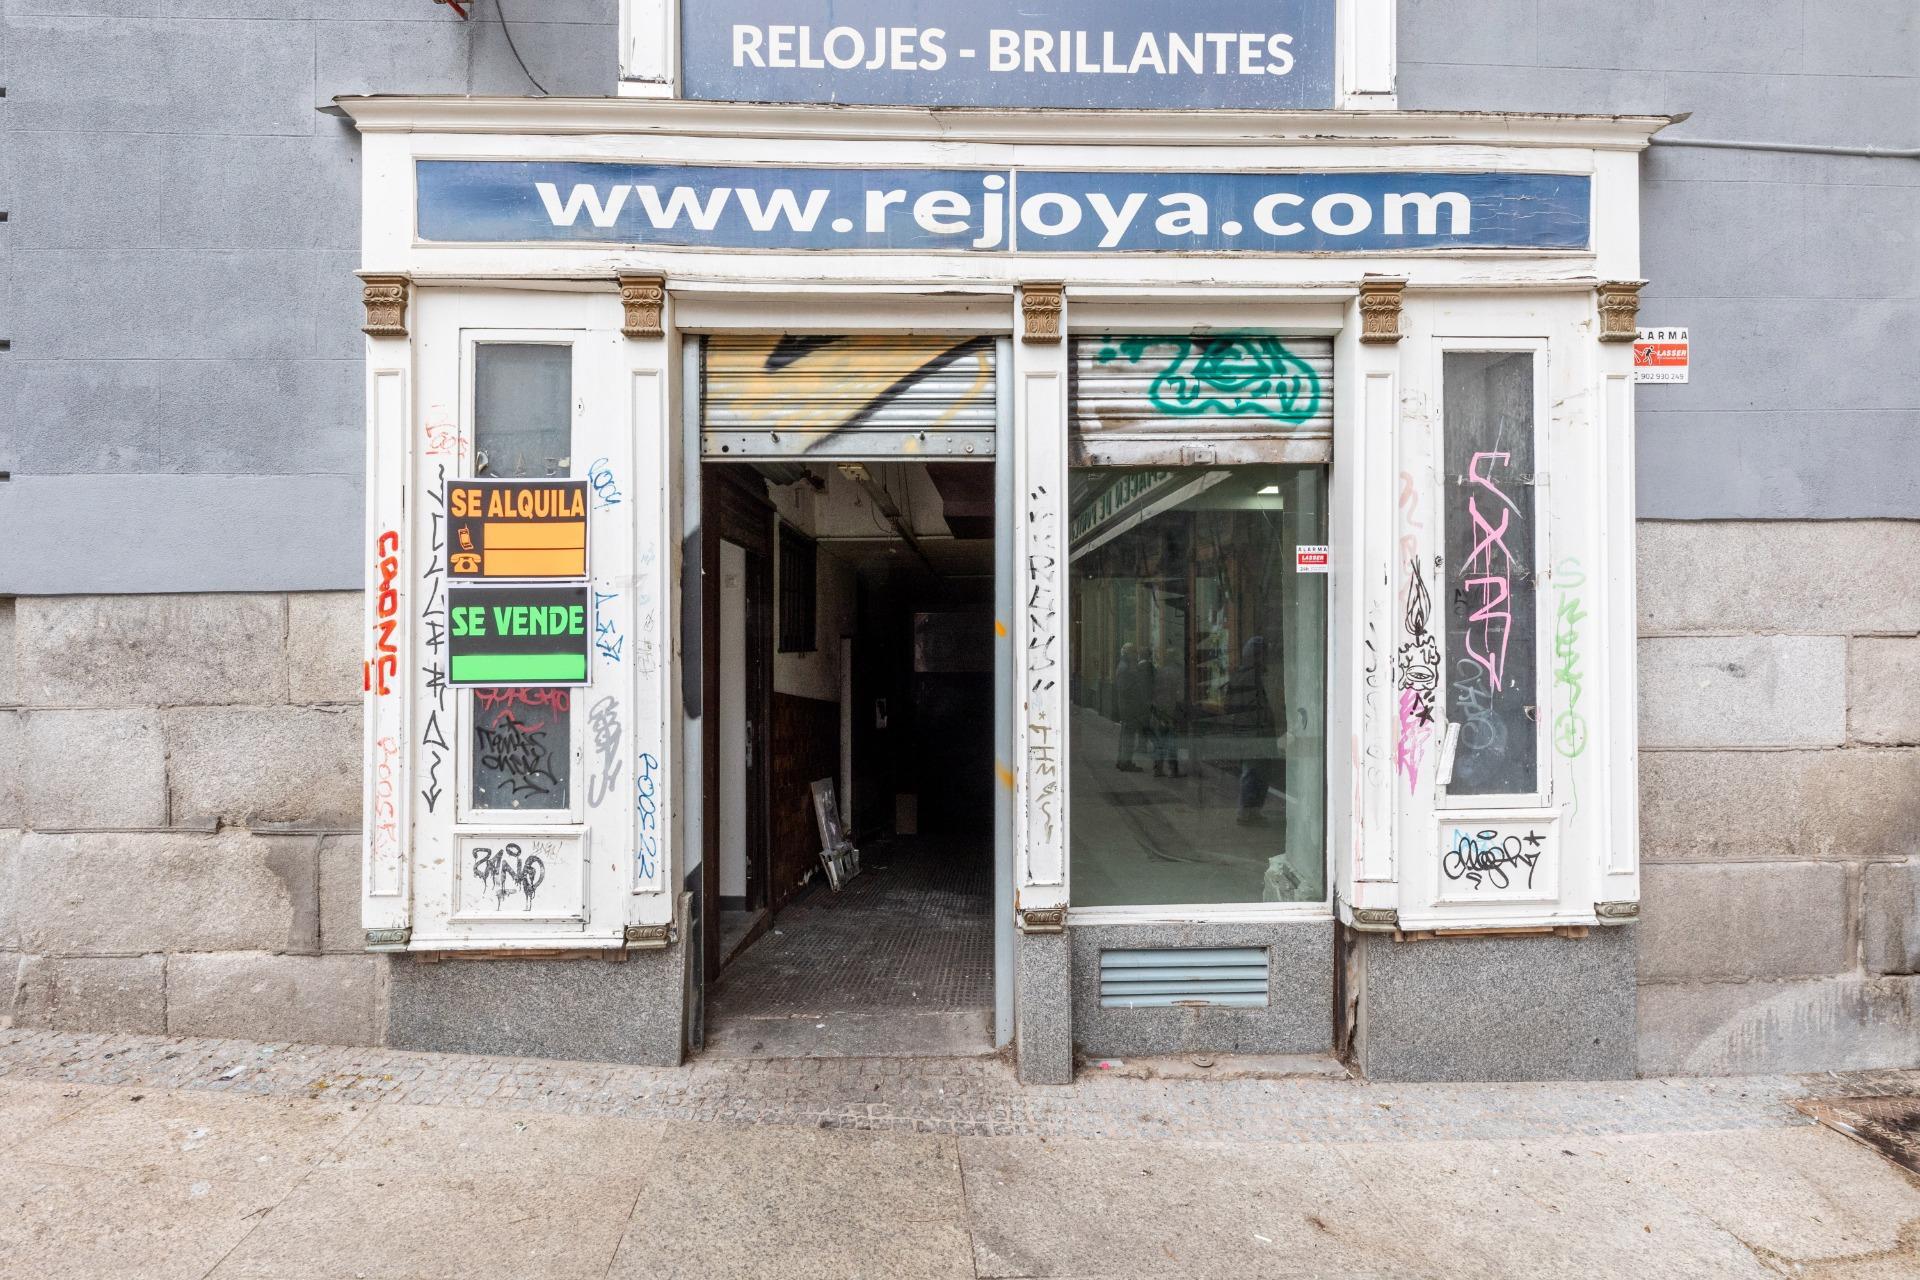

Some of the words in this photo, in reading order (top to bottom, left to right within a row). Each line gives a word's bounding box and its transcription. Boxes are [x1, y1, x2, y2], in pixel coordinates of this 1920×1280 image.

[733, 25, 947, 71] RELOJES
[989, 28, 1295, 76] BRILLANTES
[534, 174, 1473, 249] www.rejoya.com
[1639, 331, 1688, 340] LARMA
[1656, 349, 1687, 357] LASSER
[451, 488, 482, 518] SE
[487, 488, 585, 520] ALQUILA
[451, 606, 486, 636] SE
[493, 605, 585, 636] VENDE
